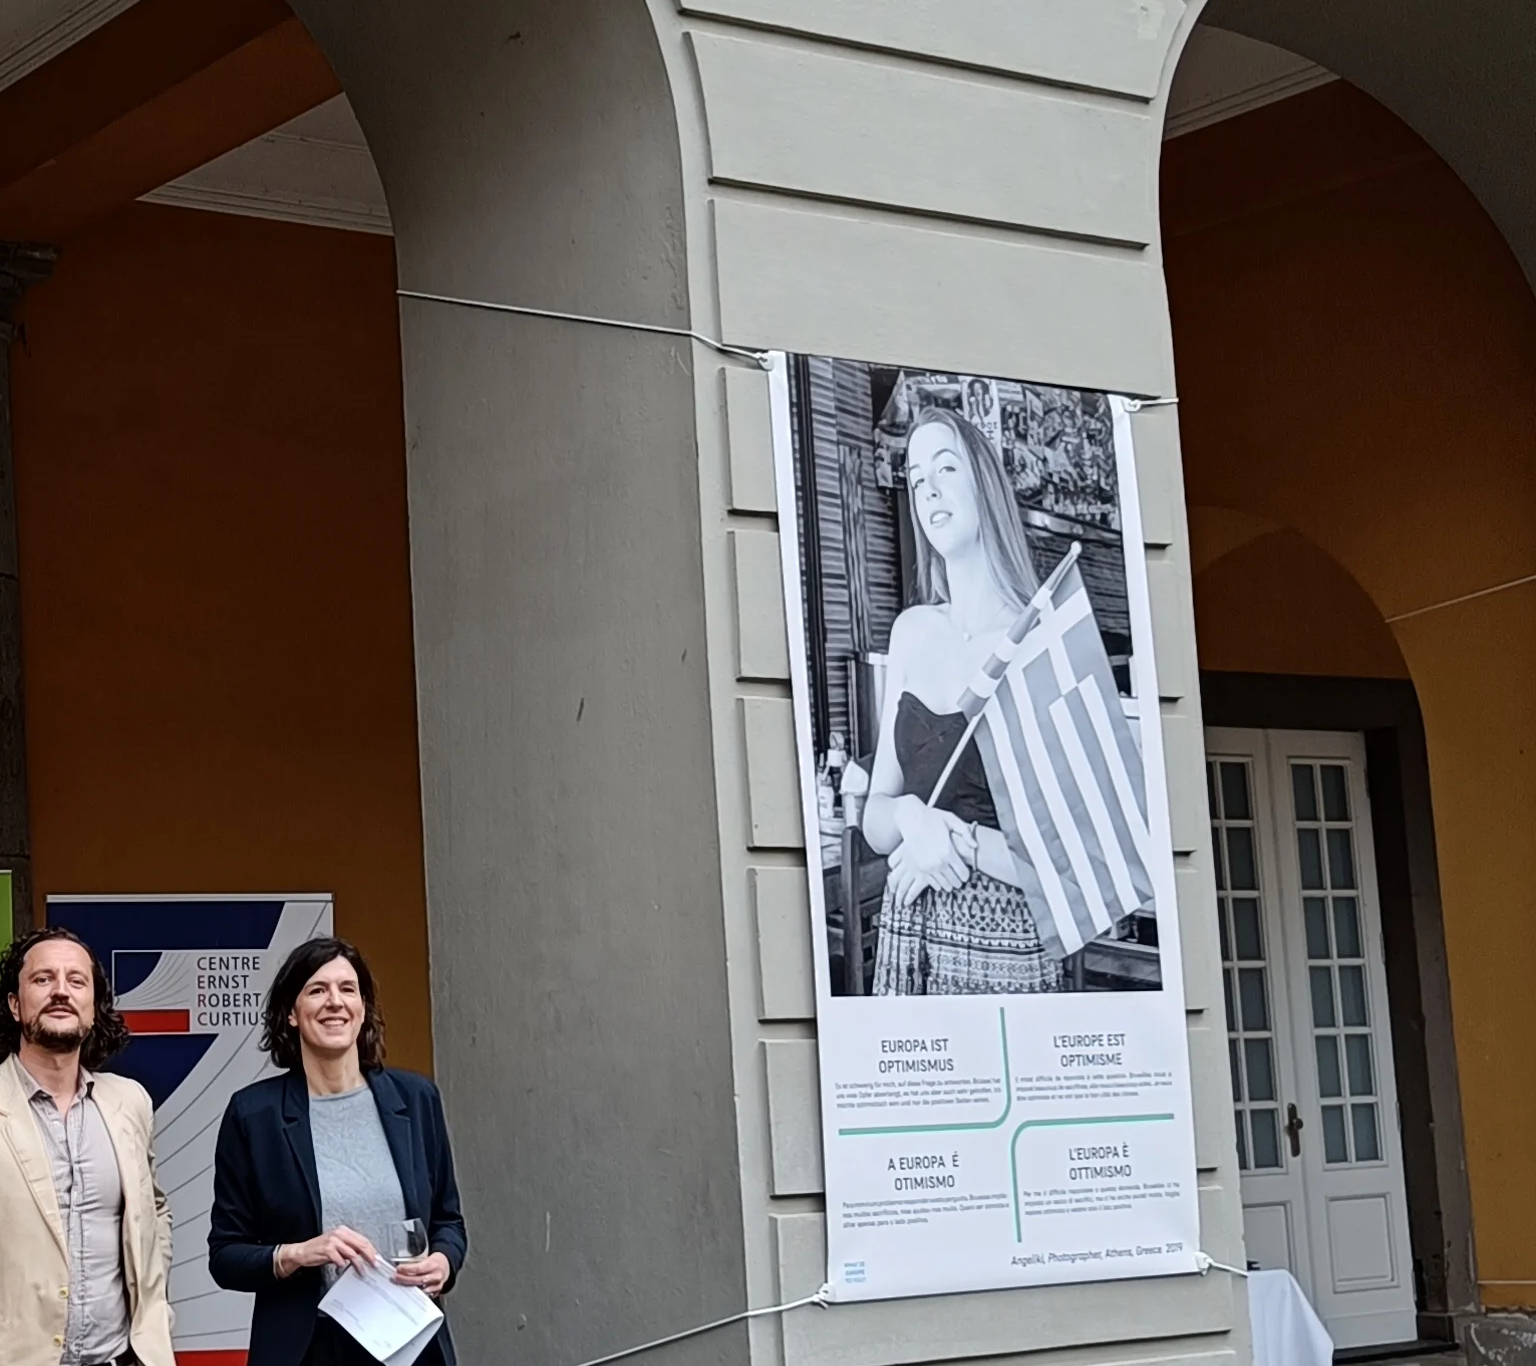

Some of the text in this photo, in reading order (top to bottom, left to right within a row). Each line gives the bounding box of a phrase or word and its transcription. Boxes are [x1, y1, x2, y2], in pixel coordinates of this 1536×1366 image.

[197, 956, 260, 970] CENTRE
[197, 975, 249, 989] ERNST
[197, 993, 261, 1007] ROBERT
[197, 1012, 267, 1026] CURTIUS
[881, 1038, 949, 1053] EUROPA IST
[1053, 1033, 1125, 1048] L'EUROPE EST
[879, 1058, 954, 1073] OPTIMISMUS
[1061, 1053, 1122, 1067] OPTIMISME
[1069, 1146, 1119, 1161] L'EUROPA
[888, 1158, 896, 1171] A
[899, 1156, 945, 1170] EUROPA
[1069, 1164, 1131, 1180] OTTIMISMO
[894, 1175, 955, 1190] OTIMISMO
